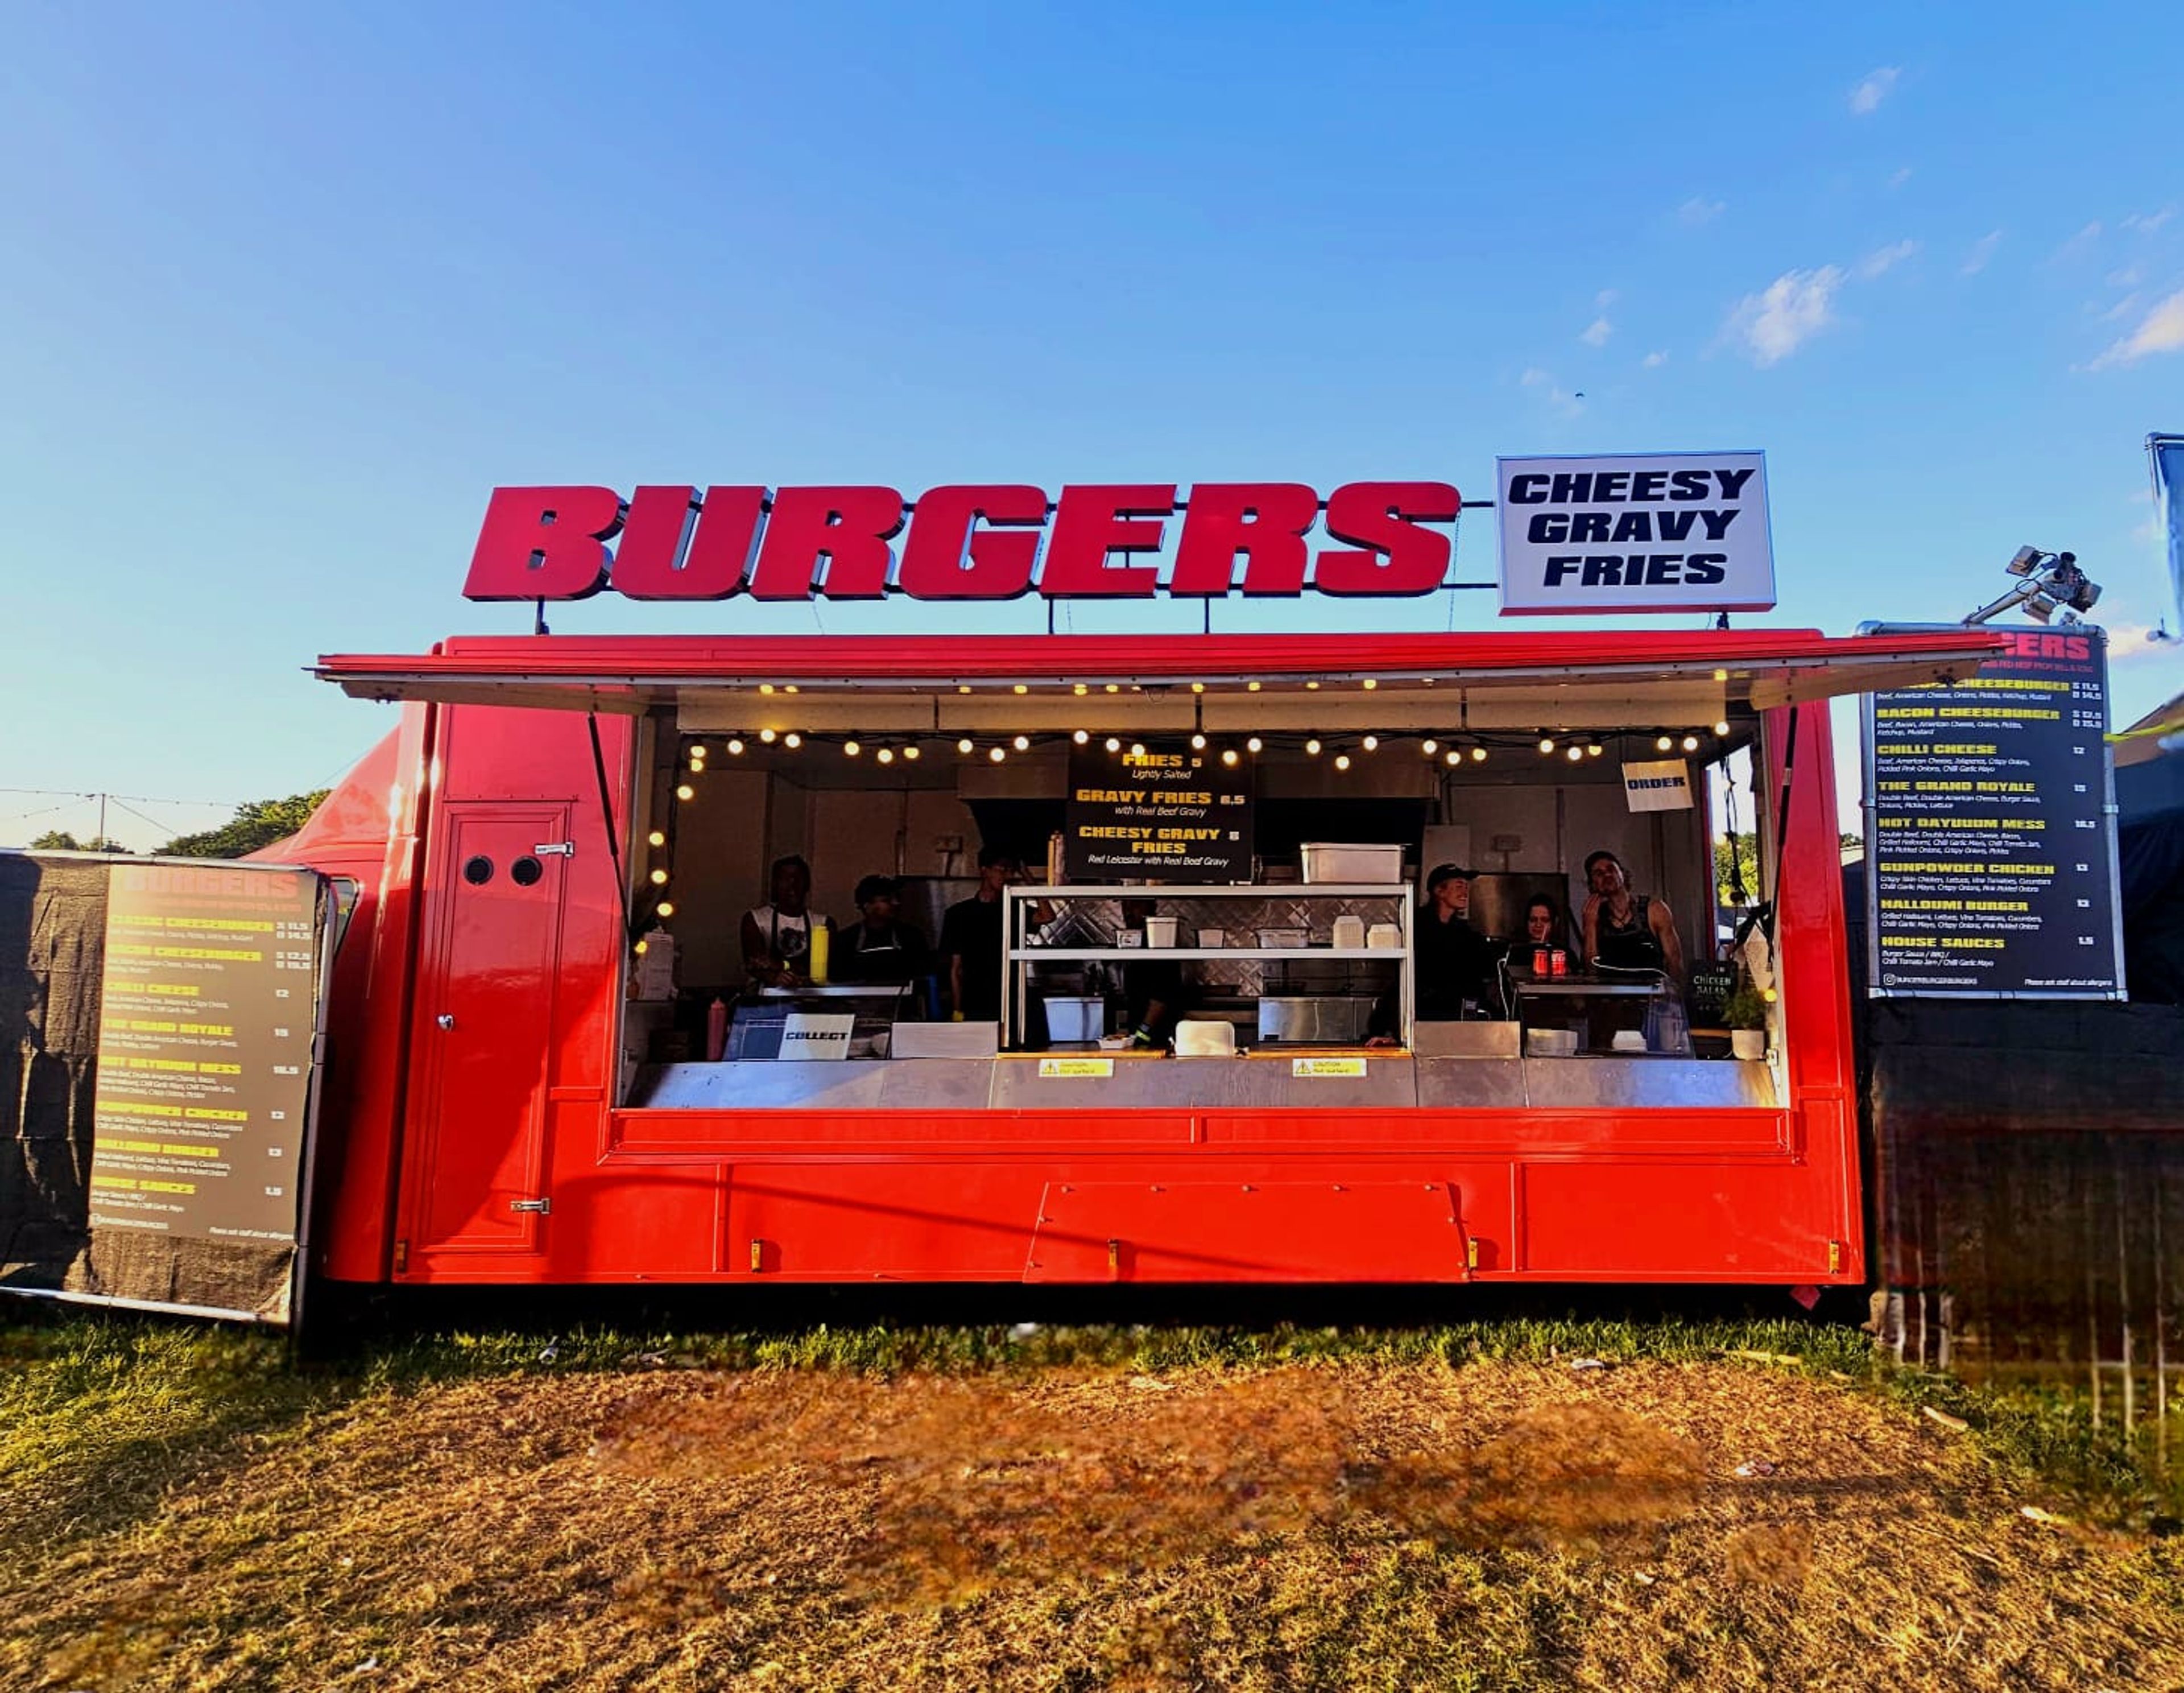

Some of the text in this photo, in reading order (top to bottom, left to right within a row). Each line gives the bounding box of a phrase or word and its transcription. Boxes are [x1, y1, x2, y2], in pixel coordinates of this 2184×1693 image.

[1508, 469, 1755, 504] CHEESY
[1527, 509, 1740, 543] GRAVY
[462, 482, 1461, 601] BURGERS
[1543, 554, 1728, 586] FRIES
[1877, 708, 1934, 717] BACON
[1877, 745, 1997, 754] CHILLI CHEESE
[1123, 753, 1202, 767] FRIES 5
[1132, 770, 1192, 779] Lightly Salted
[1628, 777, 1685, 789] ORDER
[1878, 782, 1910, 790] THE
[1977, 782, 2036, 792] ROYALE
[1077, 789, 1145, 803] GRAVY
[1152, 791, 1212, 804] FRIES
[1115, 807, 1134, 815] with
[1180, 808, 1207, 818] Gravy
[1879, 818, 1912, 827] HOT
[2003, 820, 2045, 829] MESS
[1079, 827, 1152, 839] CHEESY
[1157, 828, 1221, 840] GRAVY
[1132, 843, 1186, 853] FRIES
[1088, 855, 1105, 864] Red
[1145, 856, 1162, 865] with
[1164, 856, 1181, 865] Real
[1183, 857, 1202, 866] Beef
[1204, 857, 1229, 868] Gravy
[1880, 863, 2054, 874] GUNPOWDER CHICKEN
[1881, 900, 2028, 911] HALLOUMI BURGER
[1881, 937, 2005, 948] HOUSE SAUCES
